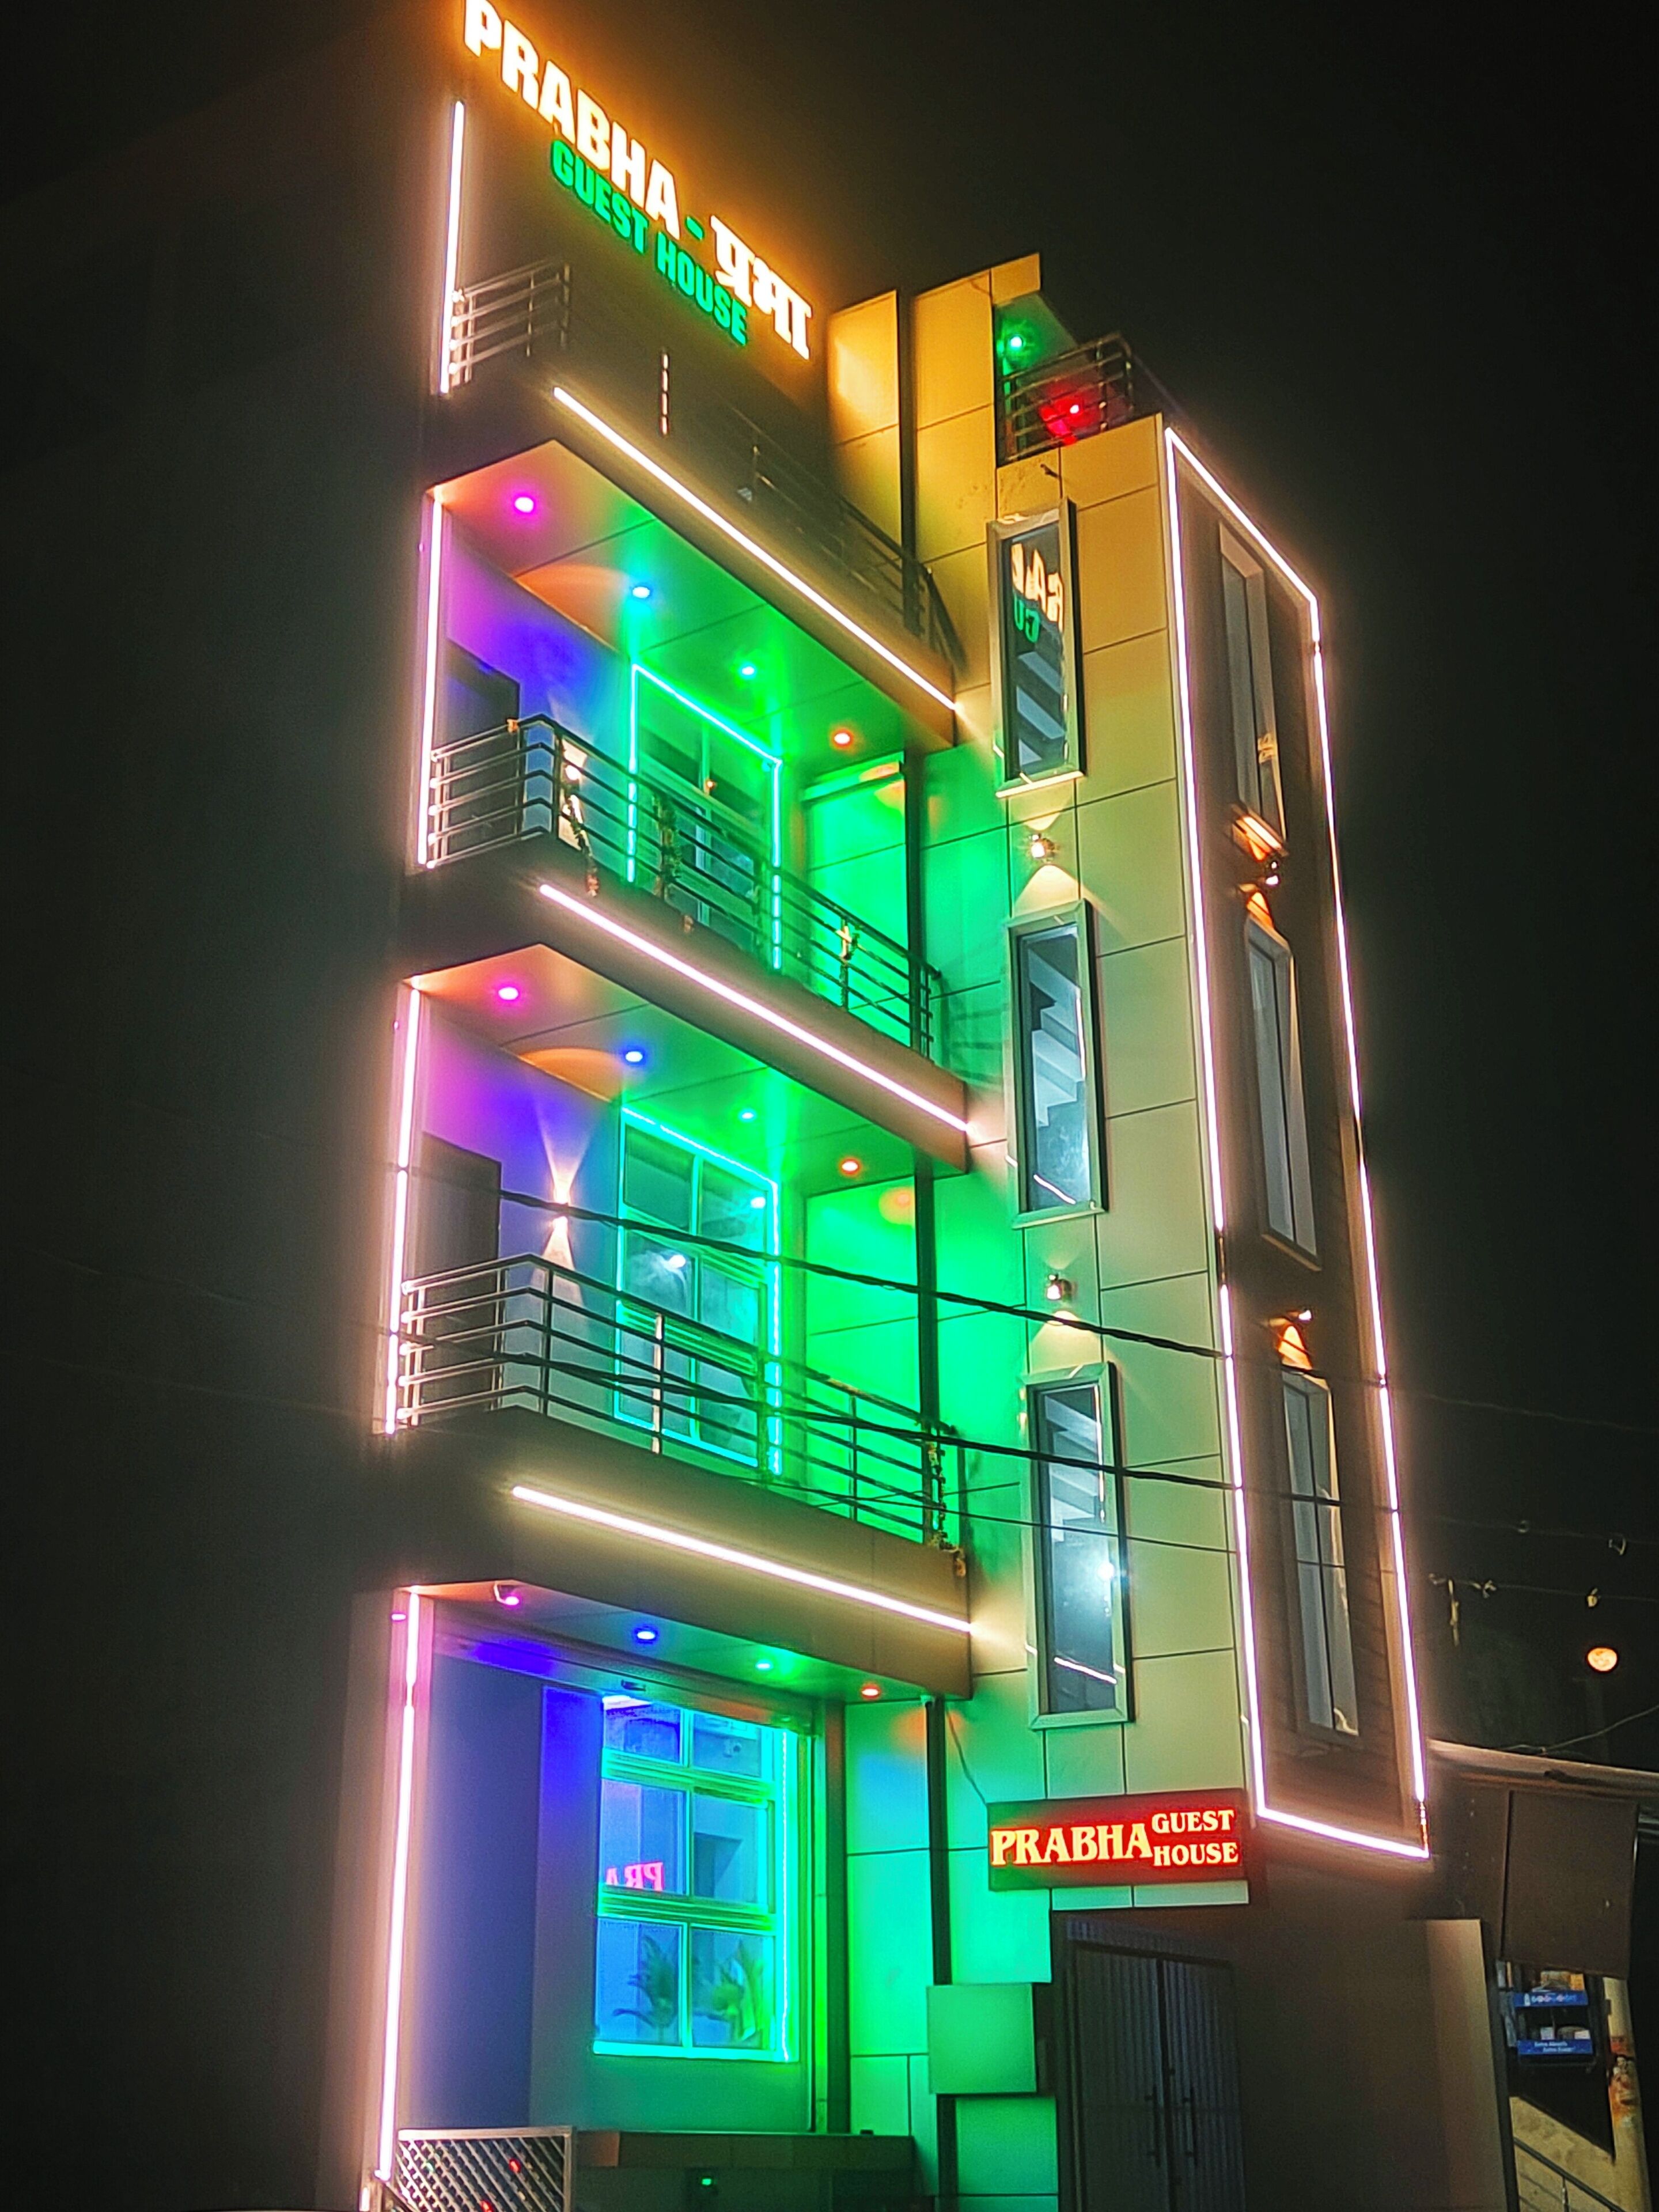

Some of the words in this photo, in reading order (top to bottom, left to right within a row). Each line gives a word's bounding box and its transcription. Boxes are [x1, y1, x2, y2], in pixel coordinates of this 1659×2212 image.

[464, 0, 680, 240] PRABHA
[551, 139, 649, 255] GUEST
[654, 230, 747, 348] HOUSE
[710, 214, 812, 360] प्रभा
[991, 1823, 1153, 1866] PRABHA
[1152, 1810, 1234, 1834] GUEST
[1153, 1842, 1239, 1866] HOUSE
